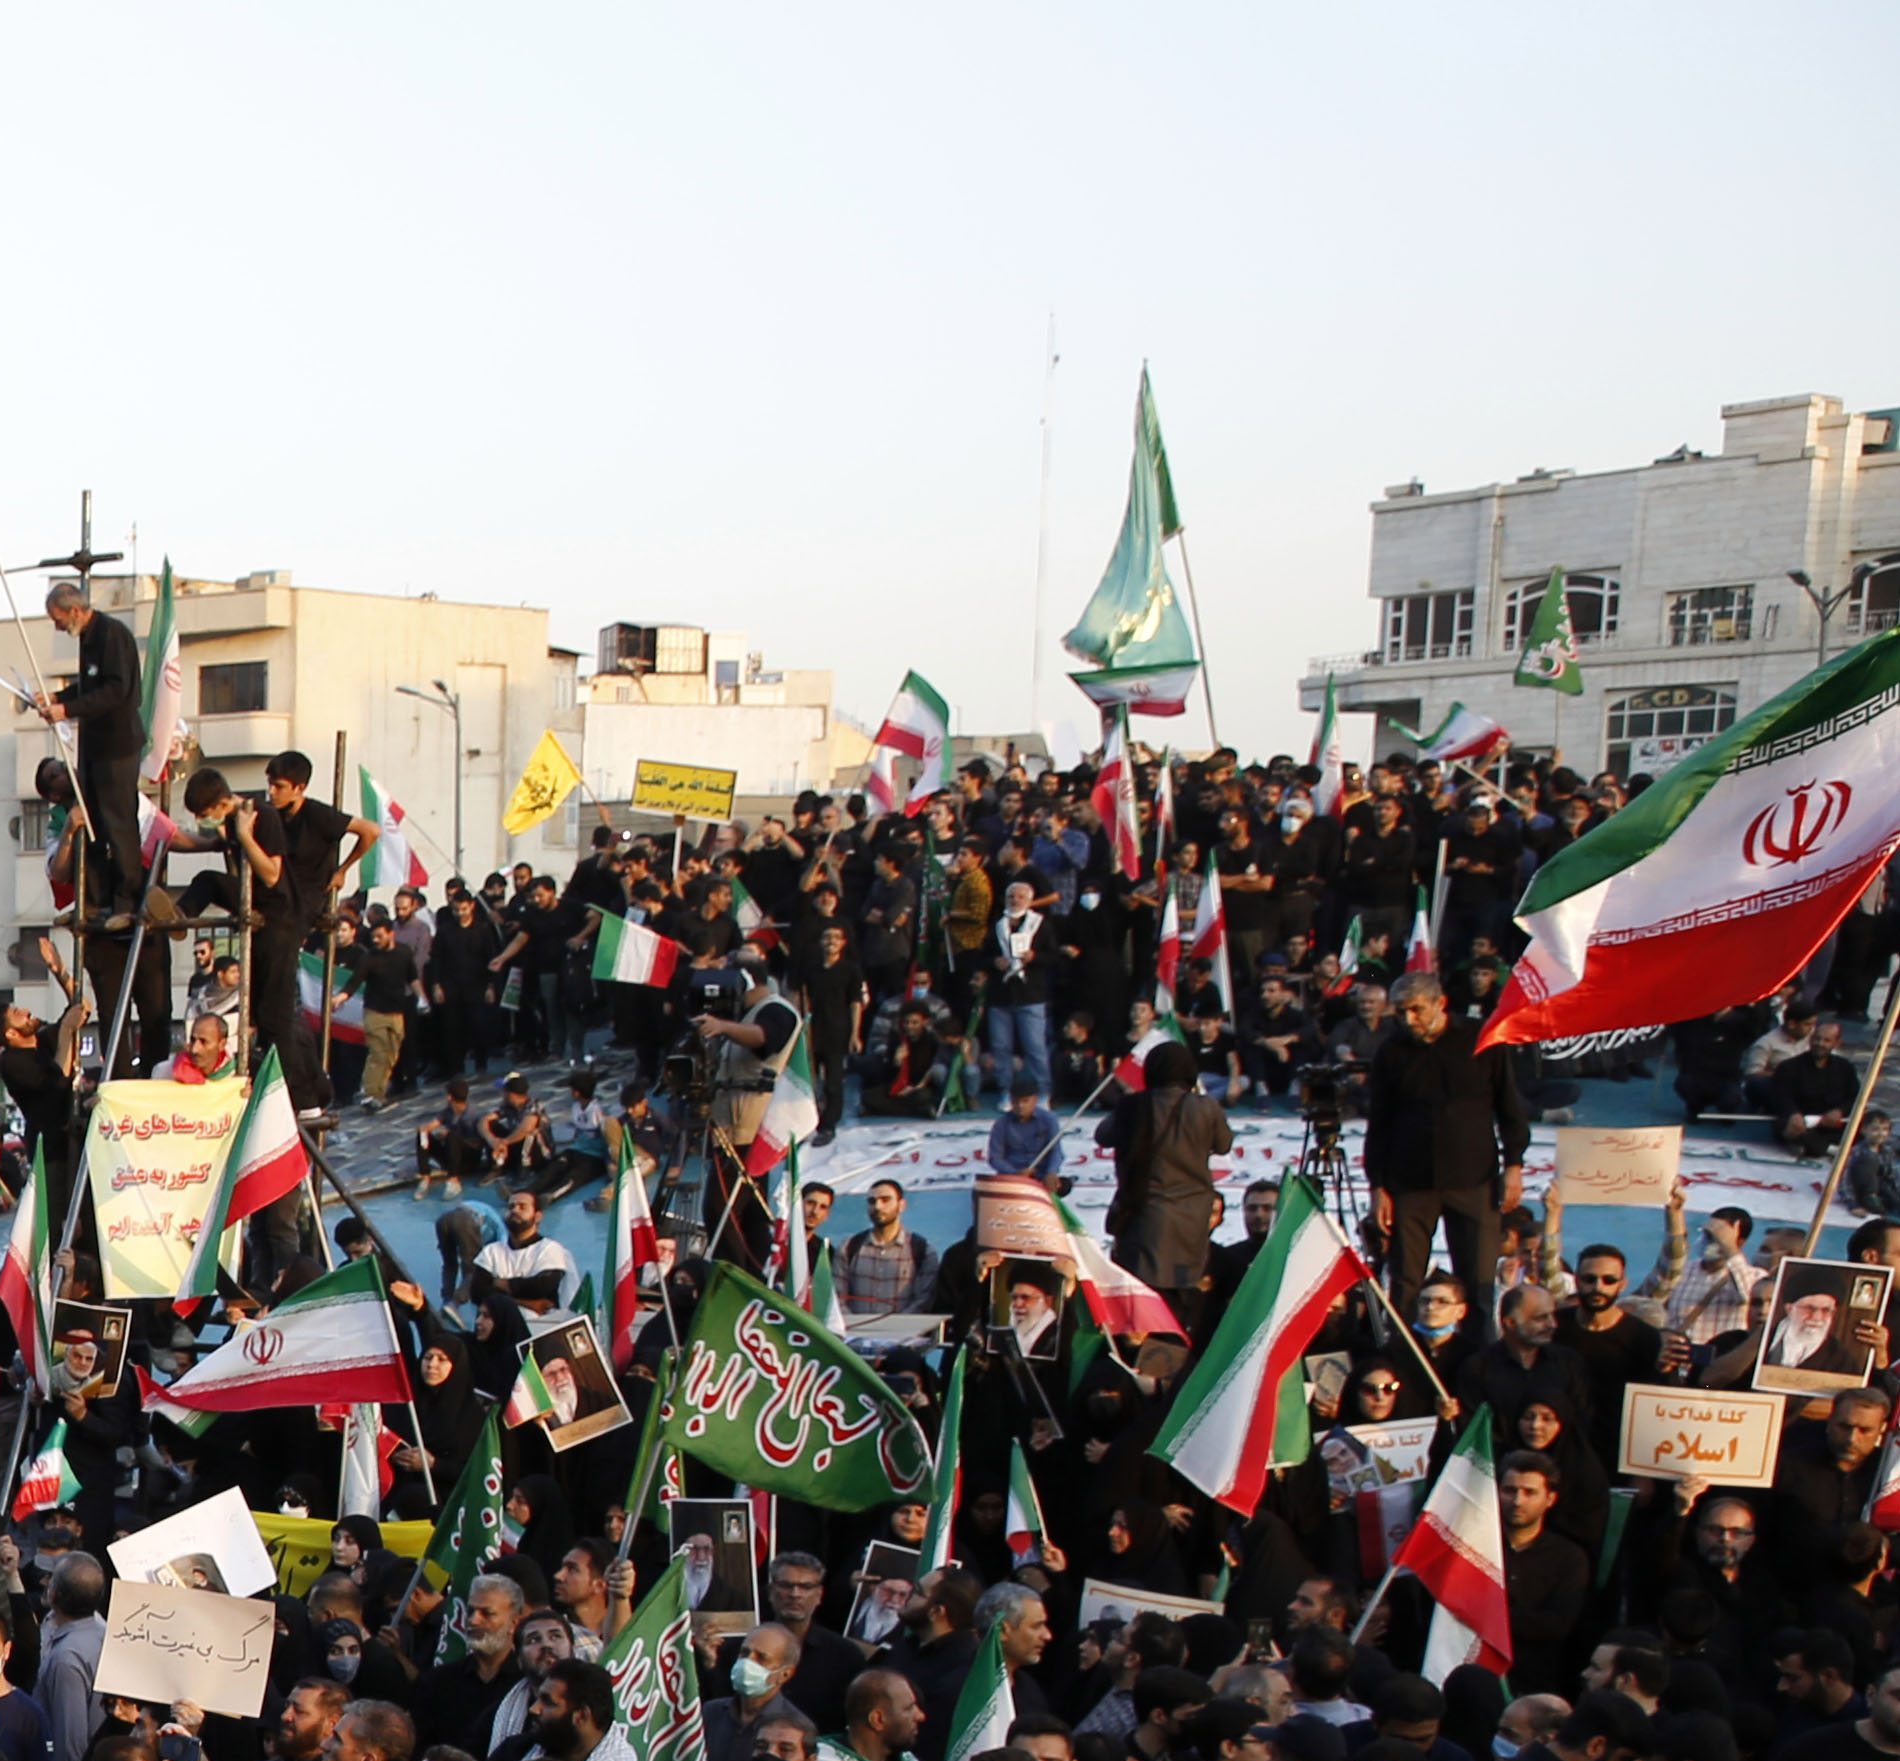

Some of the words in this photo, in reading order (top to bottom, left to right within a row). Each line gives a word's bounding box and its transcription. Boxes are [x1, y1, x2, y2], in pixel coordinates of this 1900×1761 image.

[98, 1112, 133, 1140] غرب
[136, 1115, 170, 1140] های
[111, 1163, 147, 1191] عشق
[149, 1168, 168, 1190] به
[169, 1161, 212, 1191] کشور
[177, 1216, 203, 1242] هبر
[1669, 1407, 1713, 1423] فداک
[1718, 1410, 1748, 1424] کلنا
[1653, 1431, 1739, 1464] اسلام
[217, 1614, 270, 1672] مرگ
